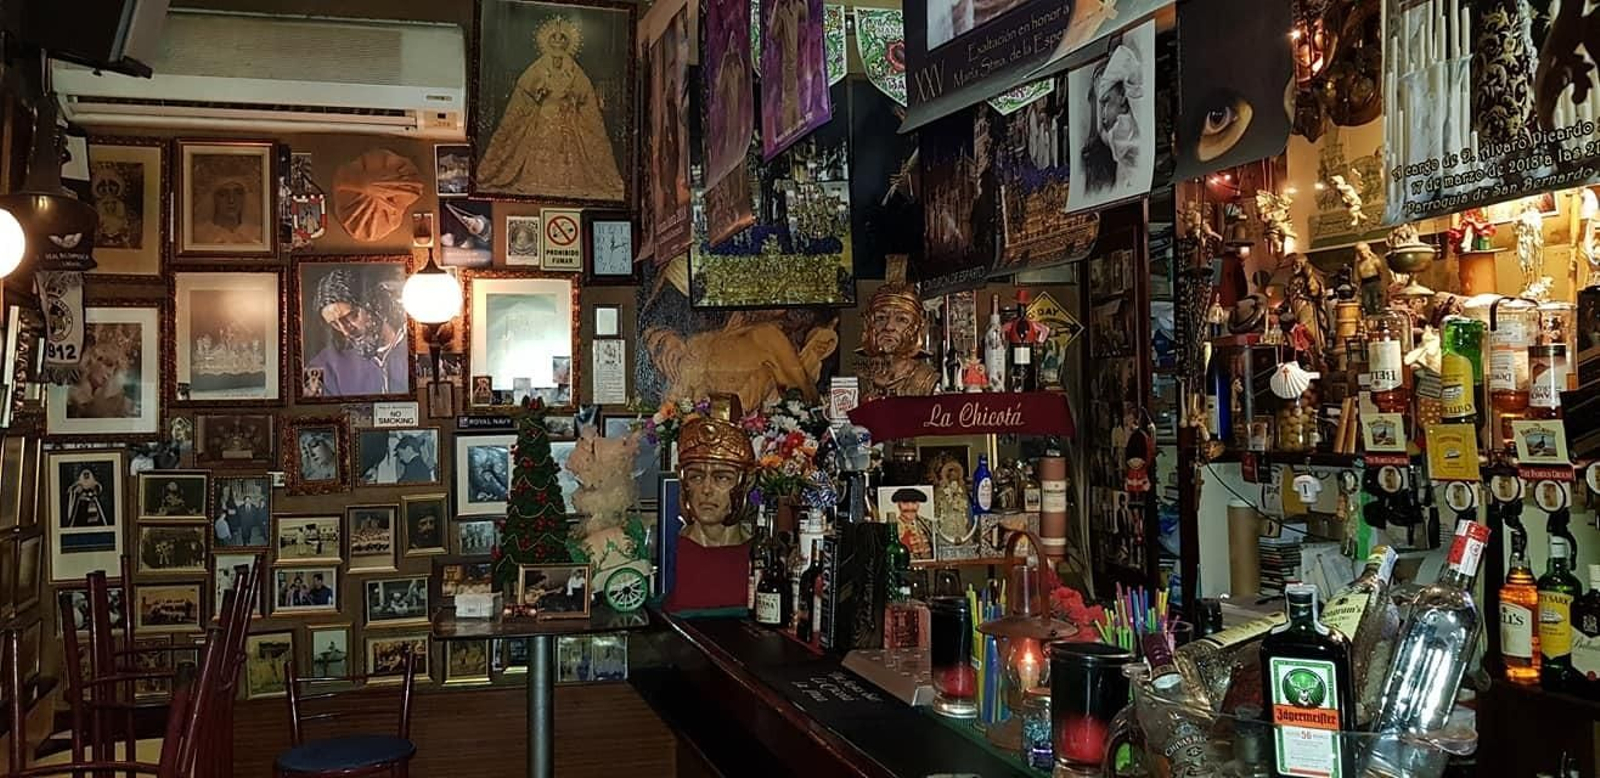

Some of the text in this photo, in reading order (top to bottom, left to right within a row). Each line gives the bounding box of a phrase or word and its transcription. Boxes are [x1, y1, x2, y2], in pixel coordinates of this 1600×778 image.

[968, 29, 1017, 62] Exaltación
[1018, 23, 1030, 36] en
[1031, 6, 1061, 32] honor
[1010, 47, 1022, 61] de
[1023, 38, 1032, 56] la
[914, 59, 945, 105] XXV
[1404, 158, 1440, 177] cargo
[1442, 153, 1458, 169] de
[1425, 176, 1441, 193] de
[1442, 169, 1485, 189] marzo
[1487, 164, 1505, 180] de
[1507, 156, 1539, 175] 2018
[1557, 146, 1580, 164] las
[1472, 187, 1490, 202] de
[1492, 181, 1519, 199] San
[1520, 166, 1594, 193] Bernardo
[468, 418, 492, 426] ROYAL
[923, 400, 1025, 428] La Chicotá
[1276, 708, 1336, 725] Jägermeister
